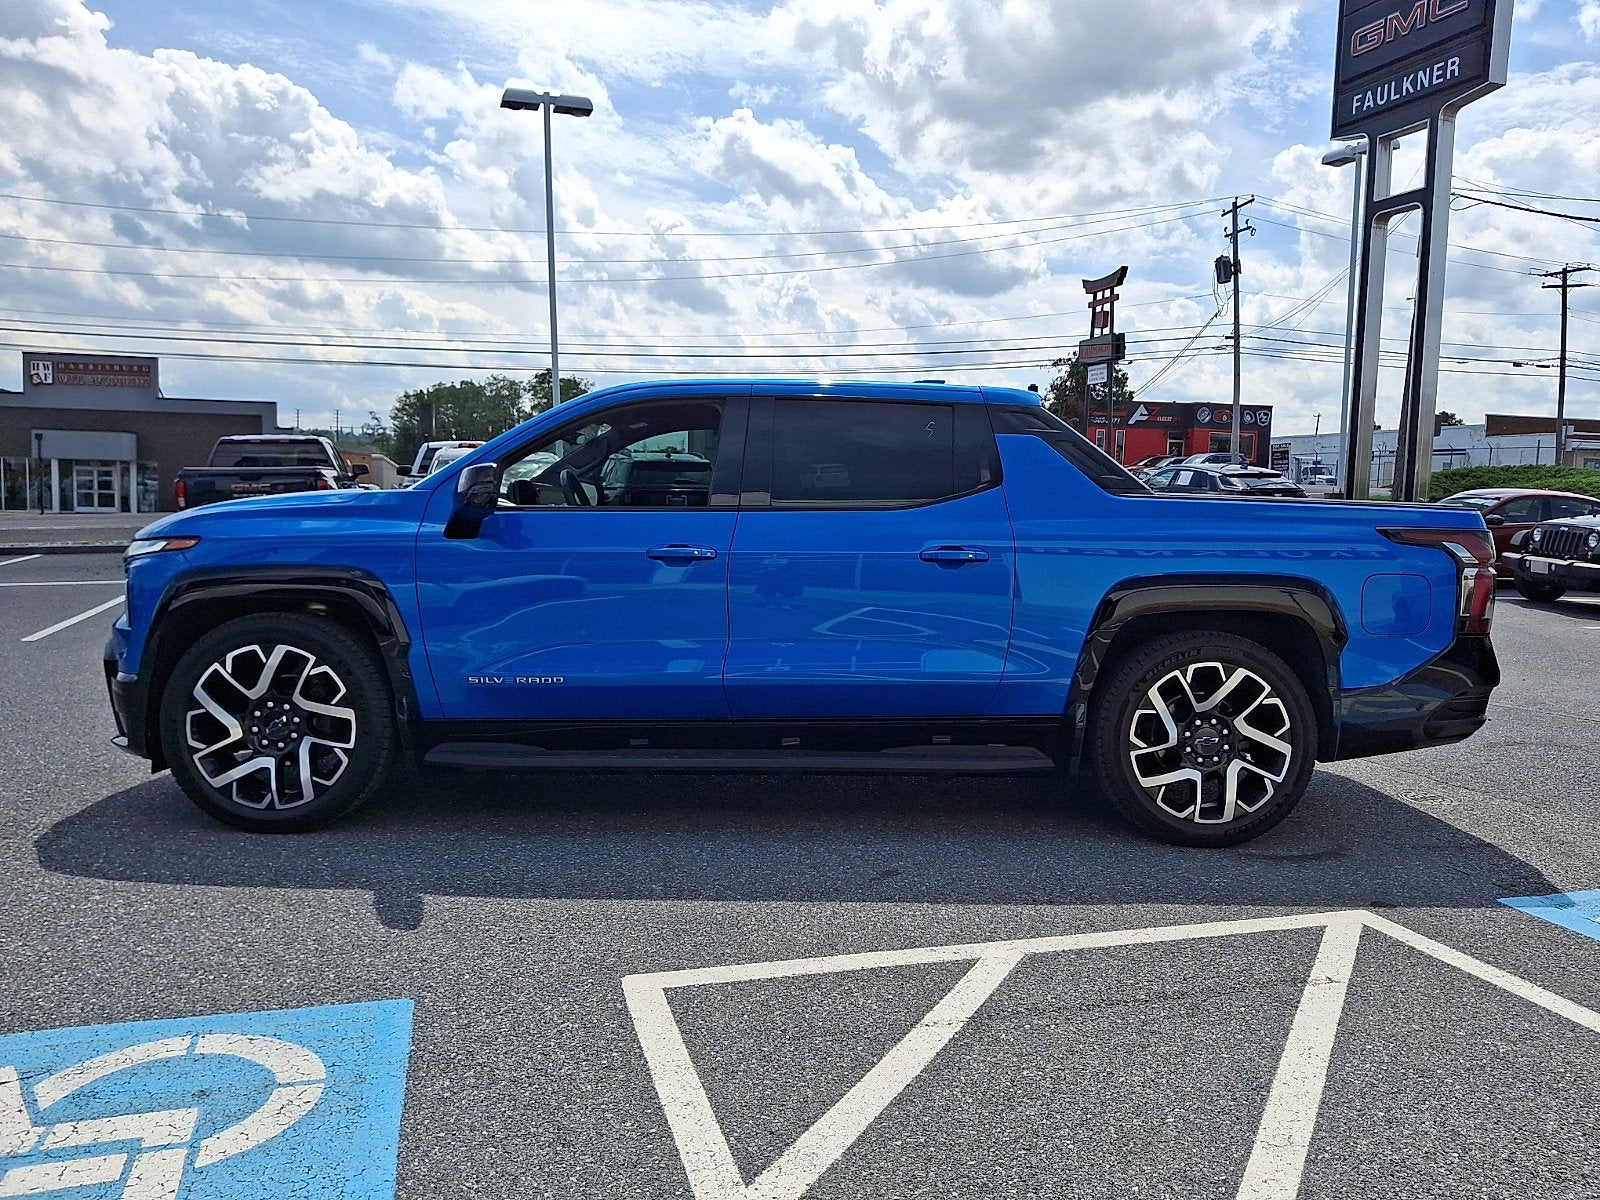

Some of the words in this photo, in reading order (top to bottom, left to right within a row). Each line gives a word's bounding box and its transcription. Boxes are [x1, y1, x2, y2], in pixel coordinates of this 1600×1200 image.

[1351, 0, 1468, 56] GMC
[1352, 56, 1460, 115] FAULKNER
[58, 362, 149, 372] HARRISBURG
[468, 676, 564, 684] SILVERADO
